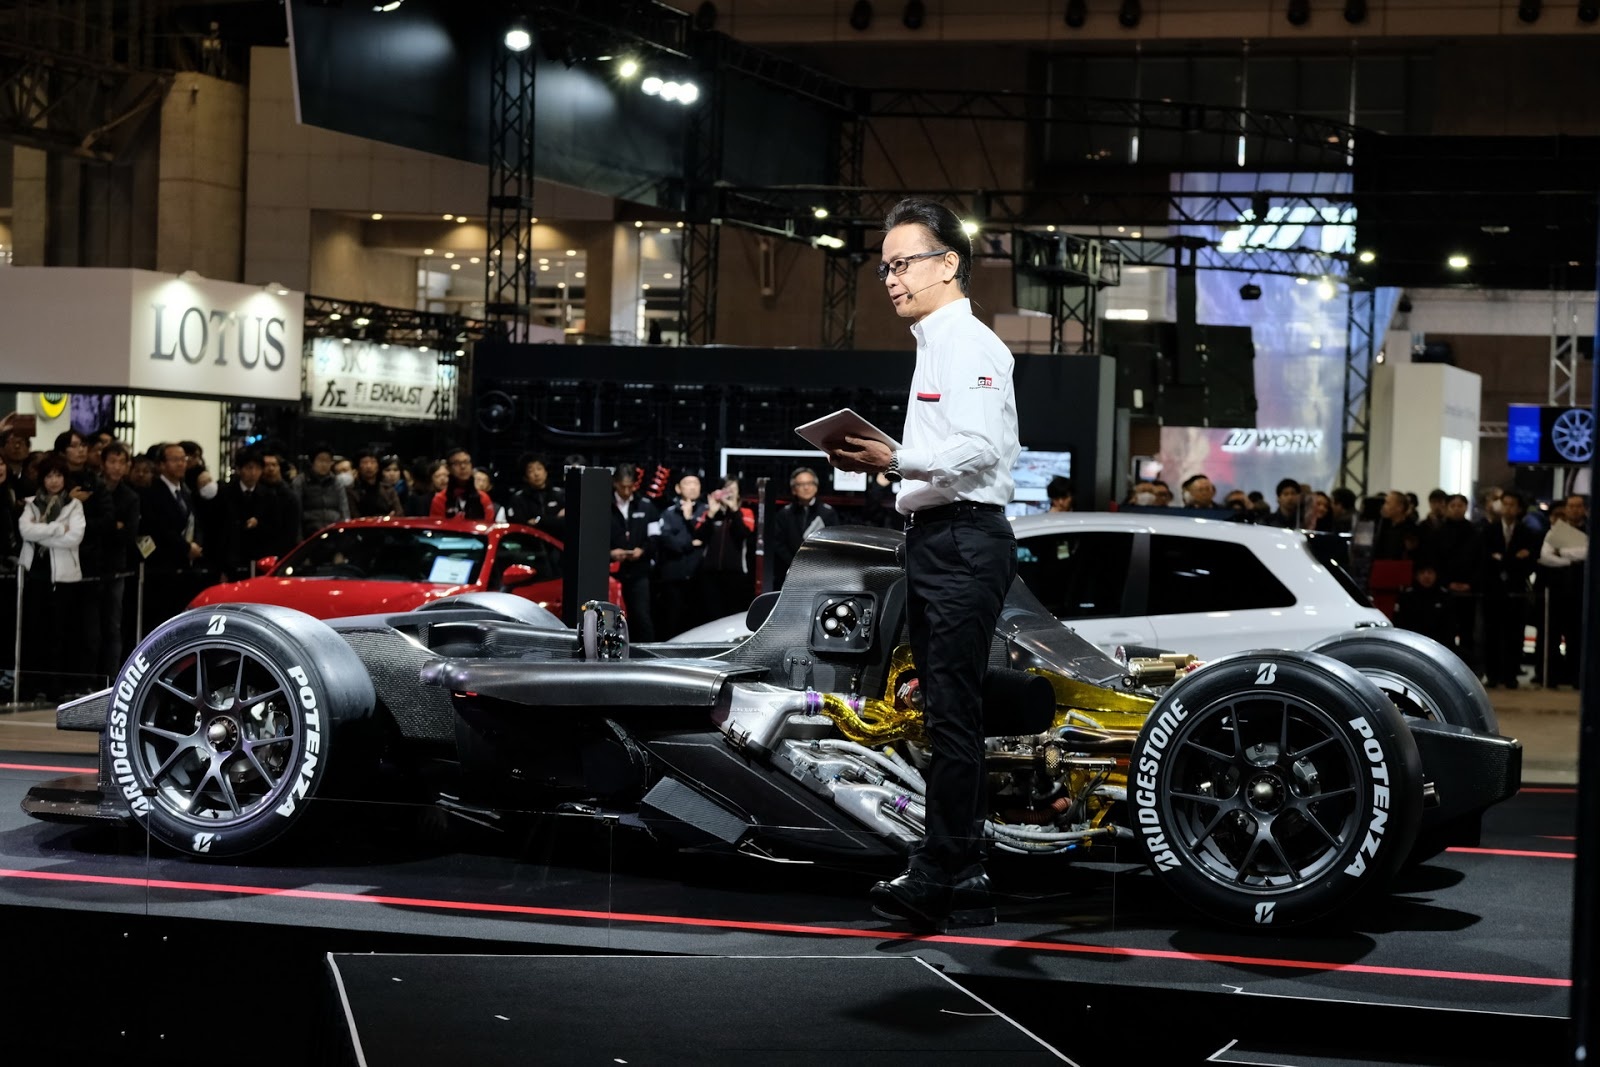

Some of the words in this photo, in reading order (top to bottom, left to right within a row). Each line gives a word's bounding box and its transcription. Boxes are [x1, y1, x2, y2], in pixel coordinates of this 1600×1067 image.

[150, 303, 287, 371] LOTUS
[370, 383, 424, 405] EXHAUST
[1256, 429, 1321, 452] WORK
[109, 651, 154, 817] BRIDGESTONE
[276, 665, 321, 818] POTENZA
[1136, 698, 1188, 871] BRIDGESTONE
[1344, 716, 1391, 878] POTENZA
